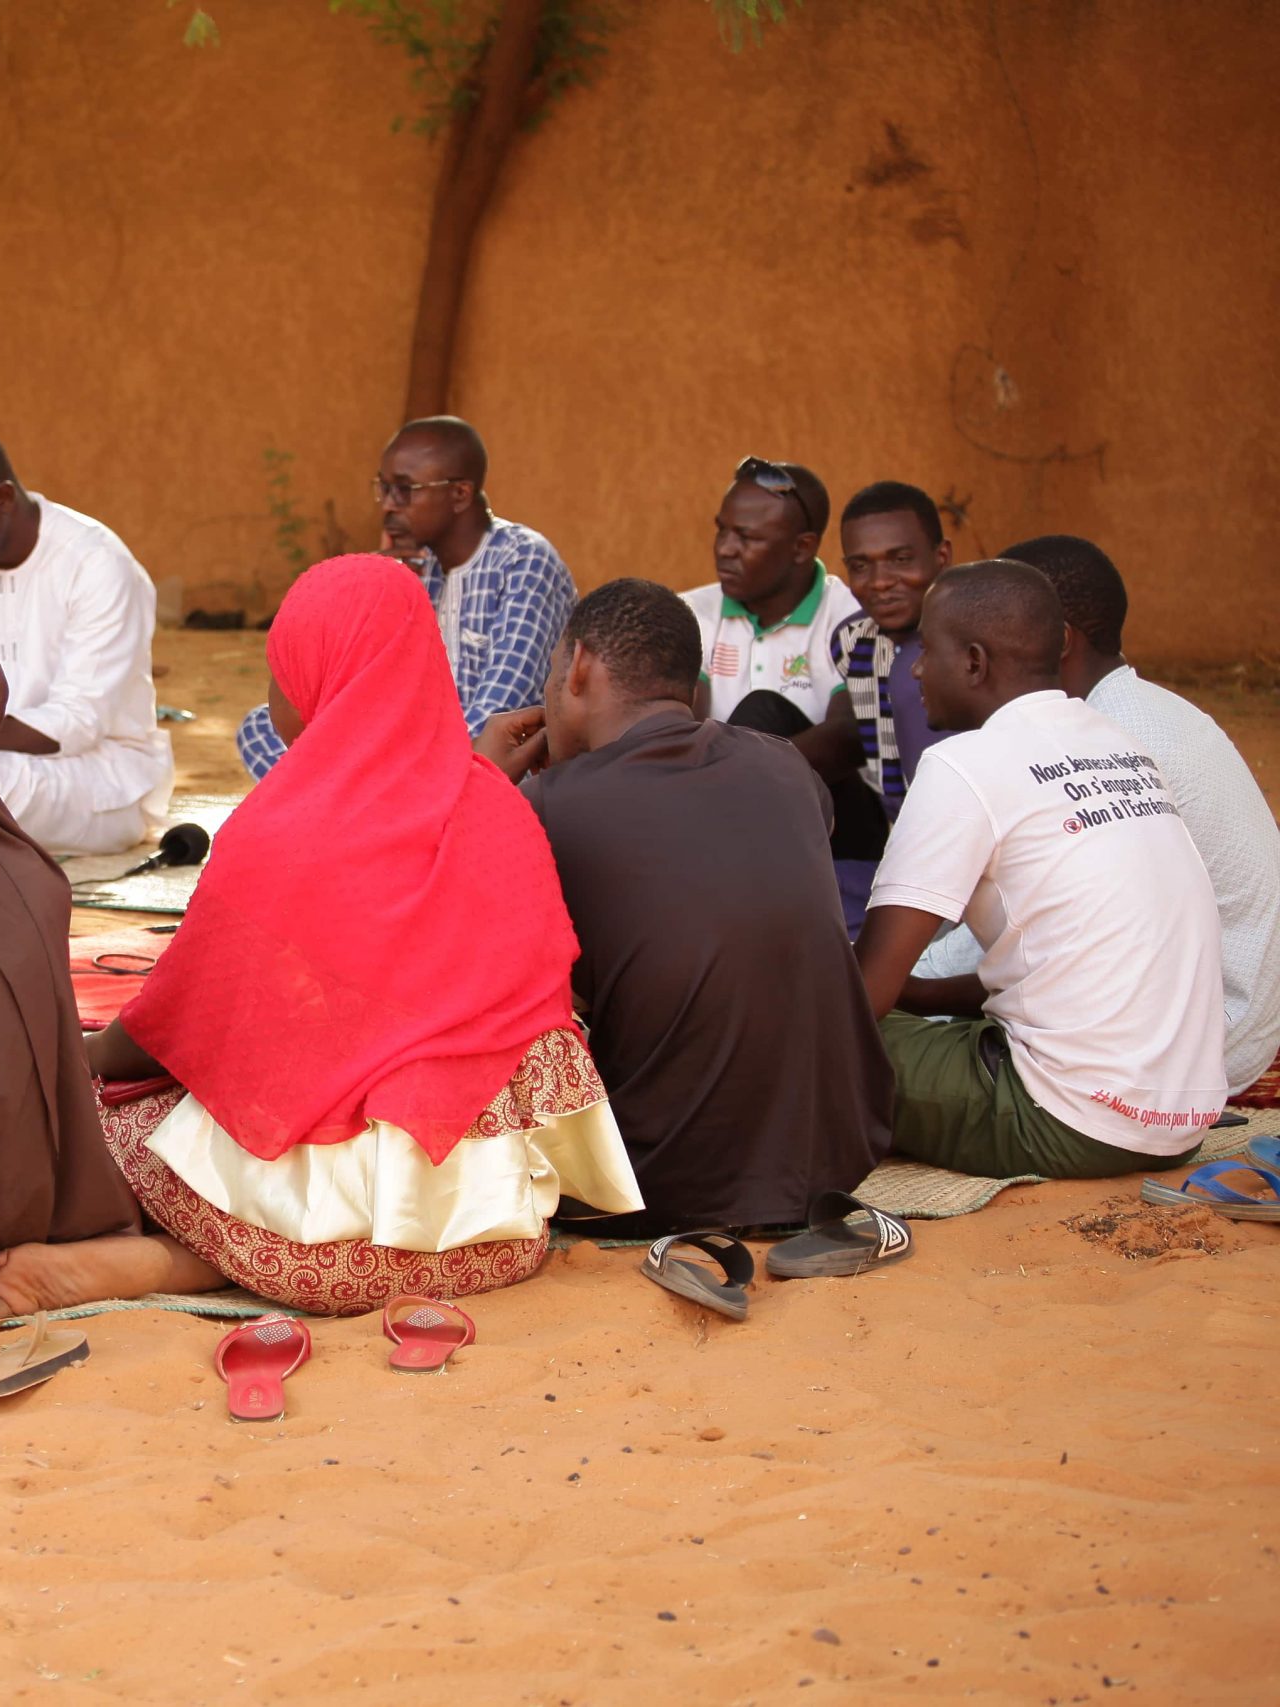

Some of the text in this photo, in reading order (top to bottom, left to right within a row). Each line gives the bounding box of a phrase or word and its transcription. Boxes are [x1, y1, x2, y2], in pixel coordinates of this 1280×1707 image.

[1029, 751, 1158, 784] Nous Jeunesse Nigéri
[1063, 782, 1092, 801] On
[1091, 775, 1143, 796] s'engage
[1137, 773, 1153, 789] à
[1075, 797, 1180, 829] Non à l'Extrémi
[1140, 1108, 1171, 1128] optons
[1170, 1111, 1189, 1131] pour
[1191, 1107, 1199, 1126] la
